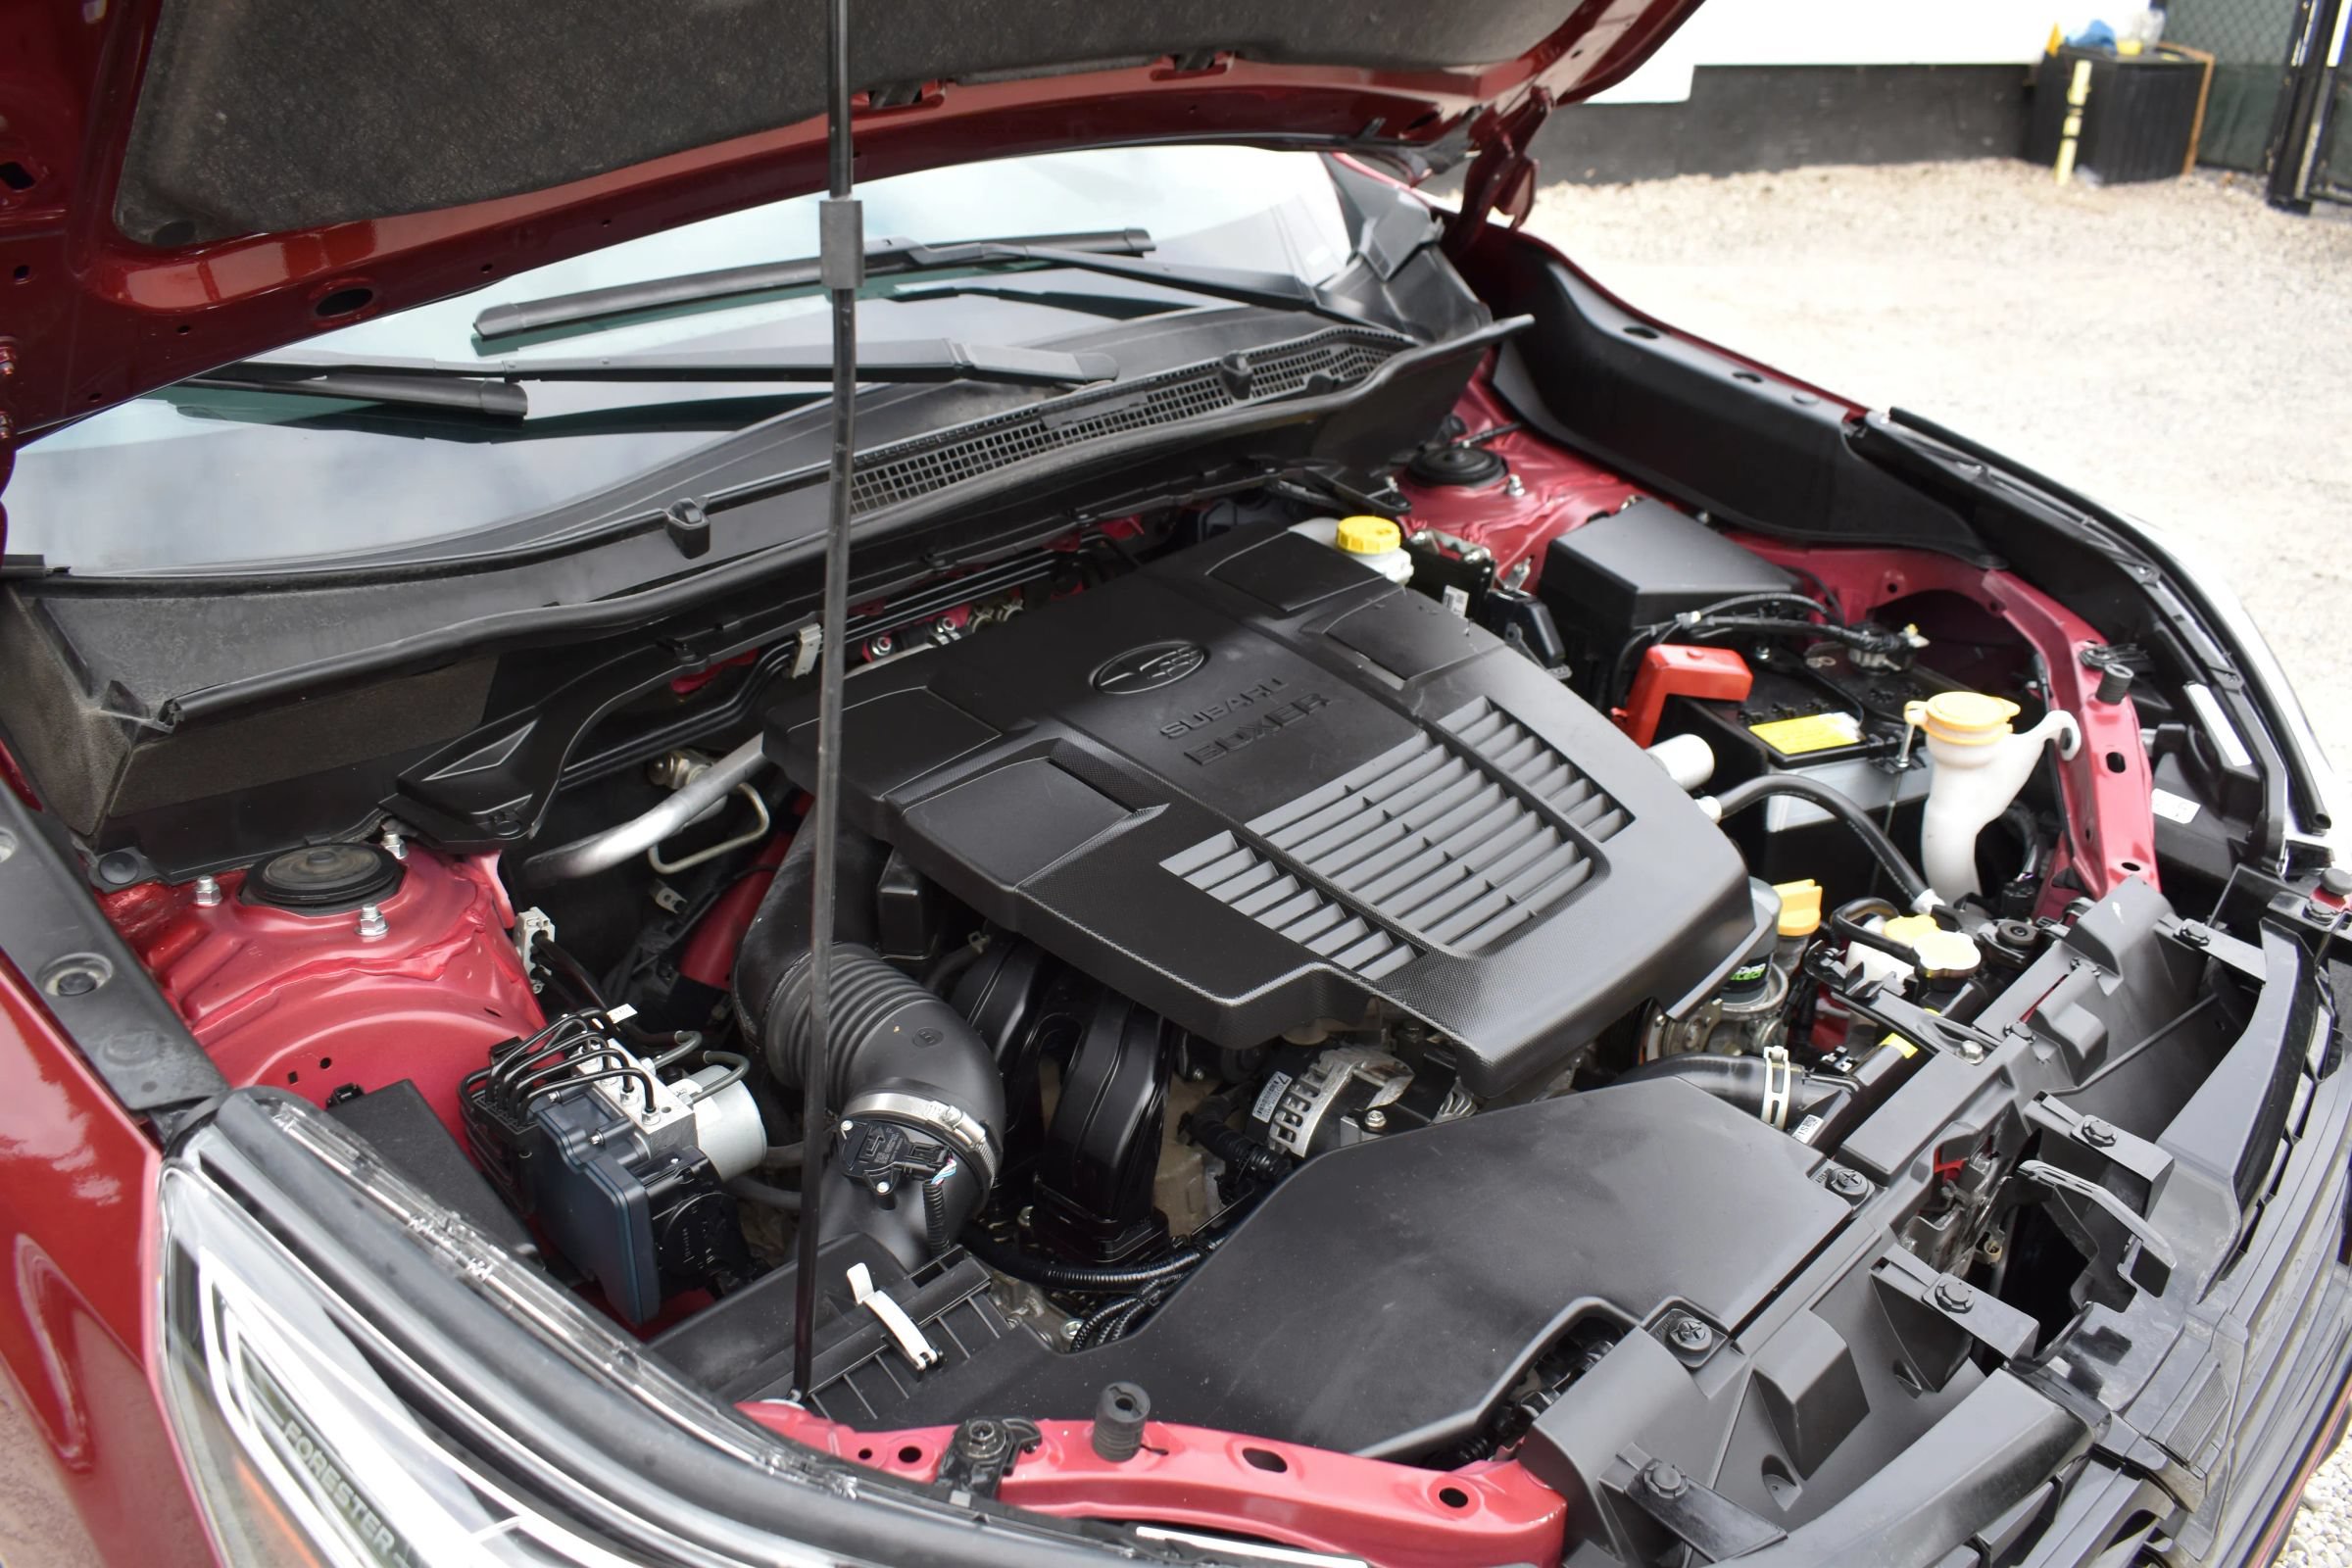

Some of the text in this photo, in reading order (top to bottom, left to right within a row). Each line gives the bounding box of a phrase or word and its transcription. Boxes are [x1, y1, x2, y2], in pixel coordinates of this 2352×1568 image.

[1160, 678, 1290, 739] SUBARU
[1184, 693, 1333, 765] BOXER
[284, 1420, 395, 1557] FORESTER
